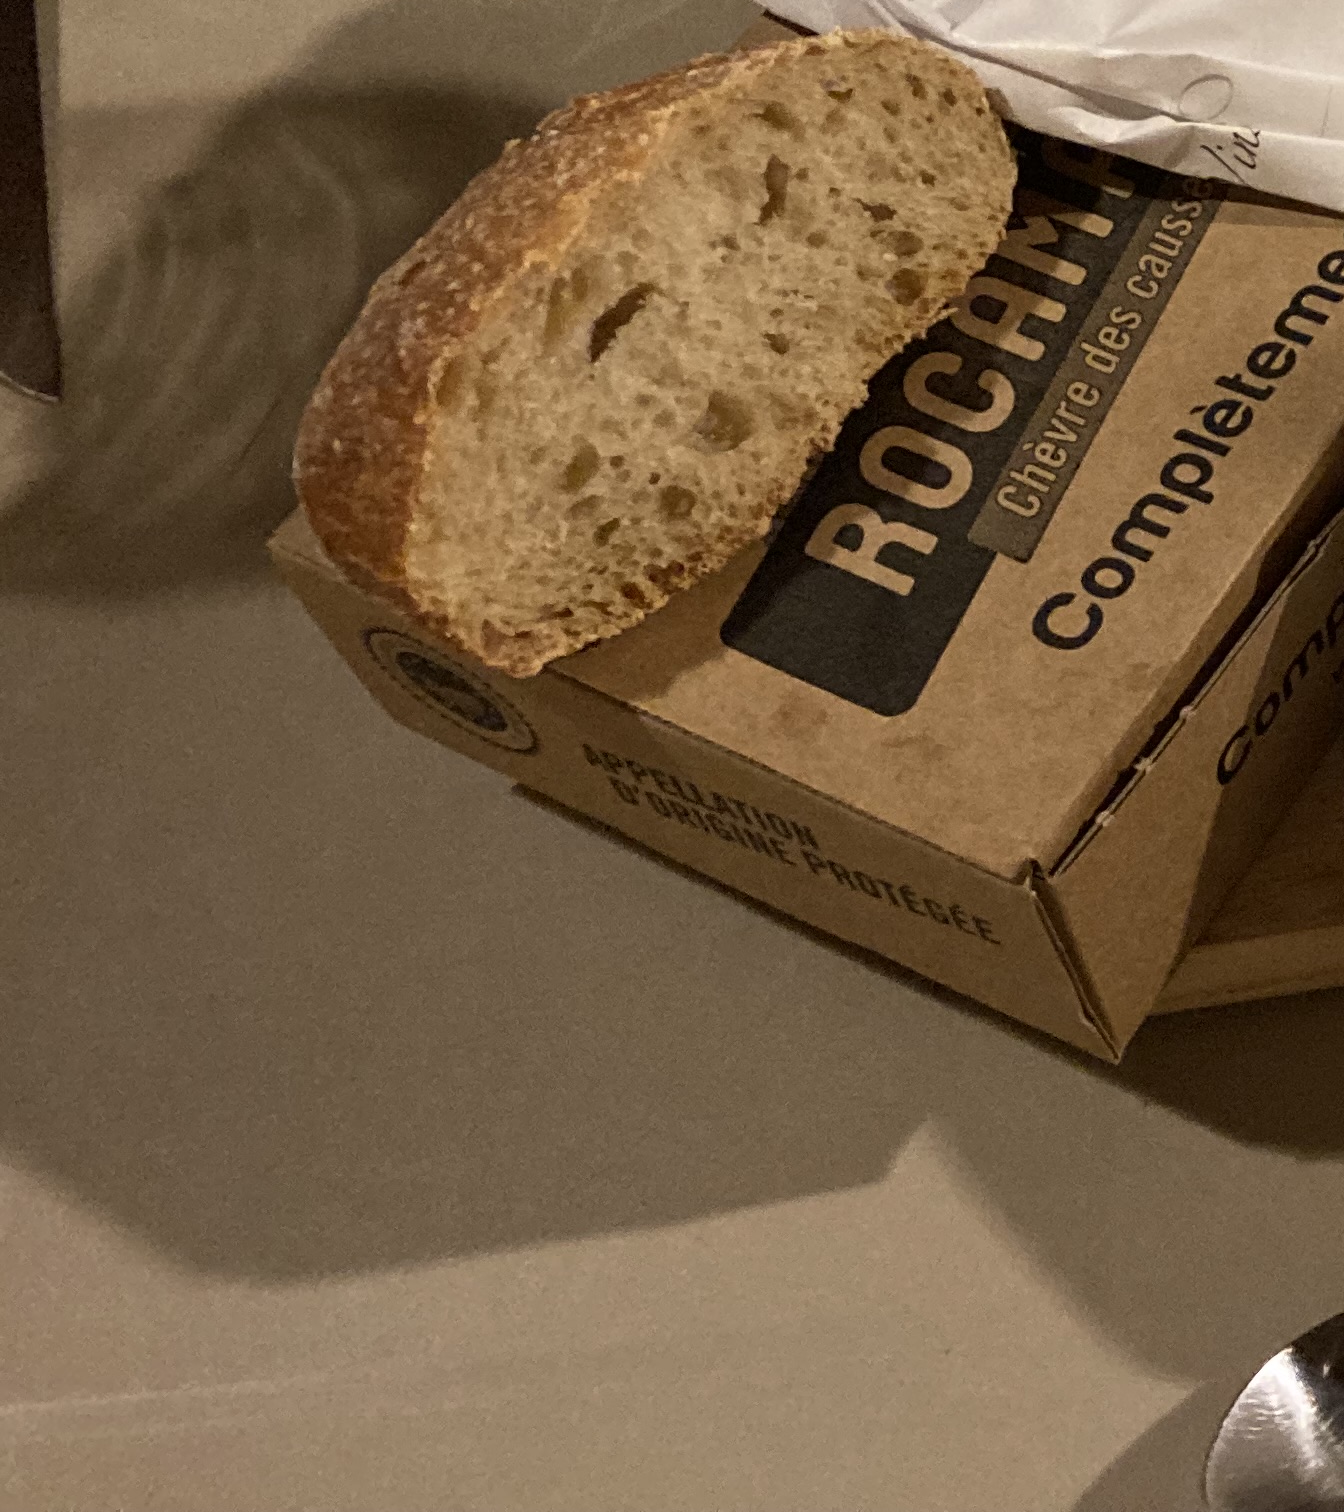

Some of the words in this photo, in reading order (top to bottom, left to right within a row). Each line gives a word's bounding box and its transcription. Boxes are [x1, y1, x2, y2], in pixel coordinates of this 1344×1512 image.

[995, 372, 1102, 517] Chèvre
[1086, 302, 1144, 373] des
[581, 741, 820, 850] APPELLATION
[612, 778, 799, 866] D'ORIGINE
[800, 846, 1001, 945] PROTÉGÉE
